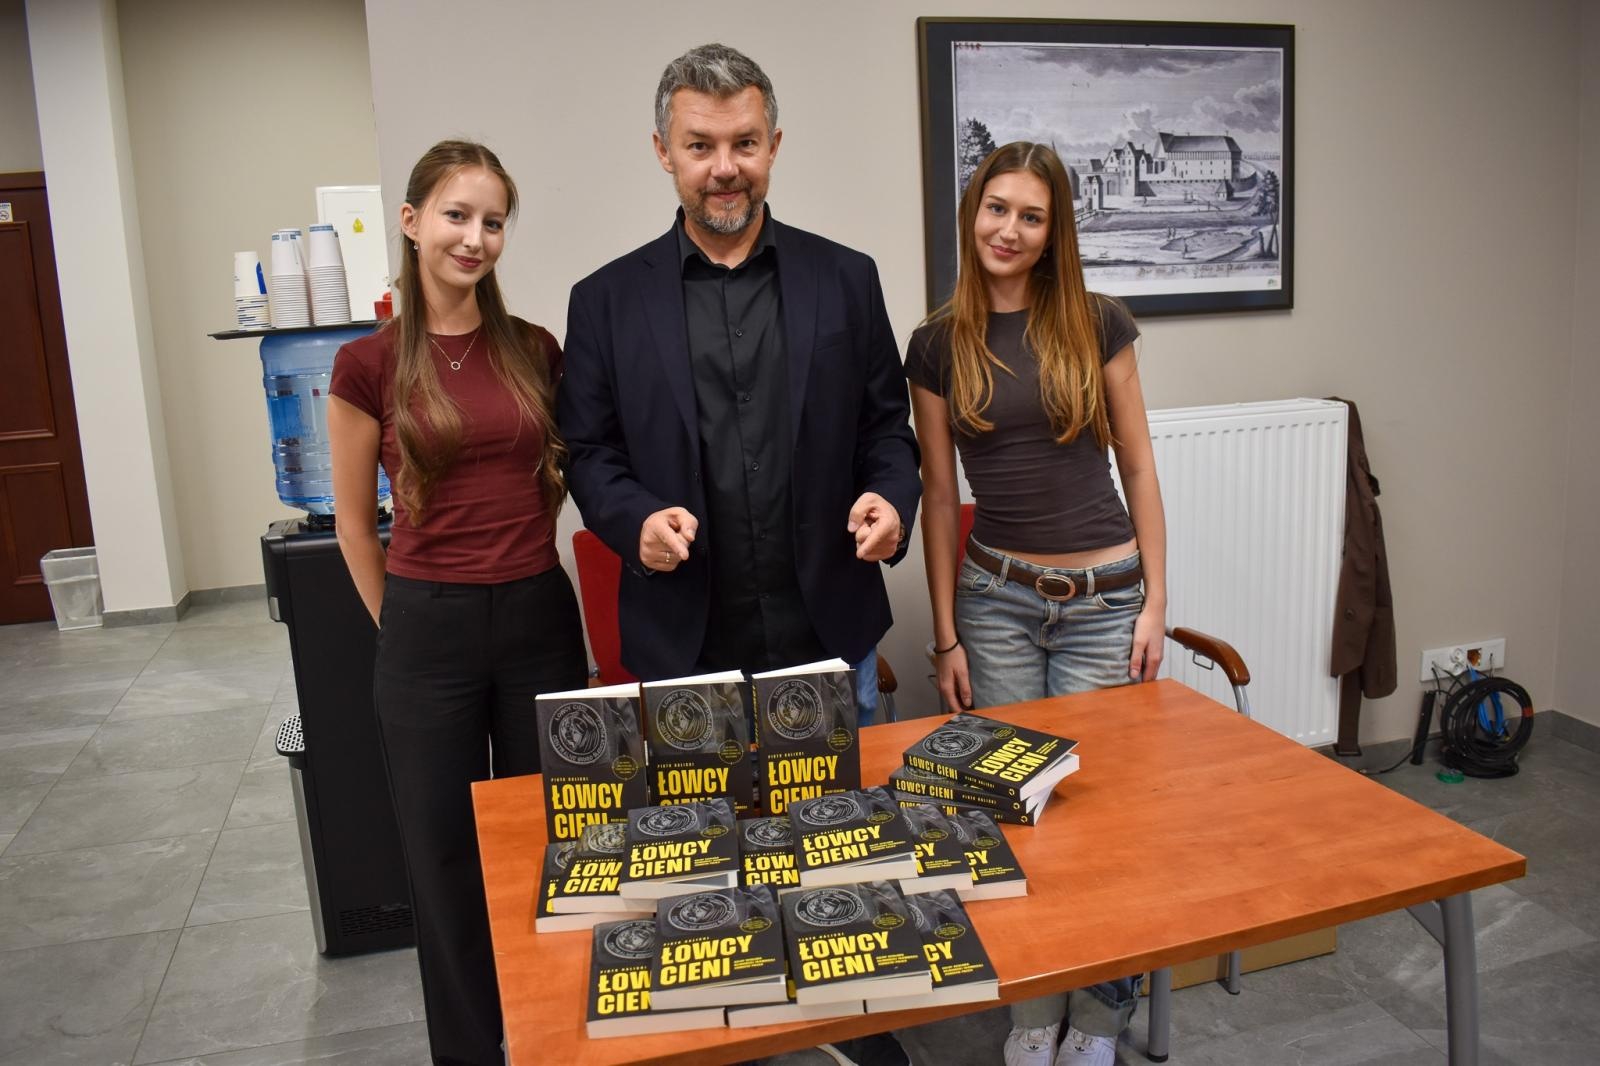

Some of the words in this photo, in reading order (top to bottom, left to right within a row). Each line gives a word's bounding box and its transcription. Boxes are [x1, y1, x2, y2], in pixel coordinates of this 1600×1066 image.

[909, 755, 934, 772] ŁOWCY
[937, 764, 958, 780] CIENI
[974, 737, 1032, 775] ŁOWCY
[1000, 752, 1048, 782] CIENI
[658, 767, 729, 796] ŁOWCY
[768, 755, 838, 786] ŁOWCY
[552, 783, 624, 810] ŁOWCY
[896, 780, 926, 794] ŁOWCY
[930, 786, 954, 800] CIENI
[631, 840, 712, 862] ŁOWCY
[803, 825, 880, 852] ŁOWCY
[630, 857, 692, 878] CIENI
[744, 854, 794, 872] ŁOW
[806, 843, 868, 866] CIENI
[570, 862, 623, 878] ŁOW
[746, 870, 799, 886] CIEN
[564, 877, 620, 893] CIEN
[662, 934, 752, 965] ŁOWCY
[799, 931, 889, 961] ŁOWCY
[660, 958, 731, 986] CIENI
[802, 953, 875, 982] CIENI
[598, 970, 652, 993] ŁOW
